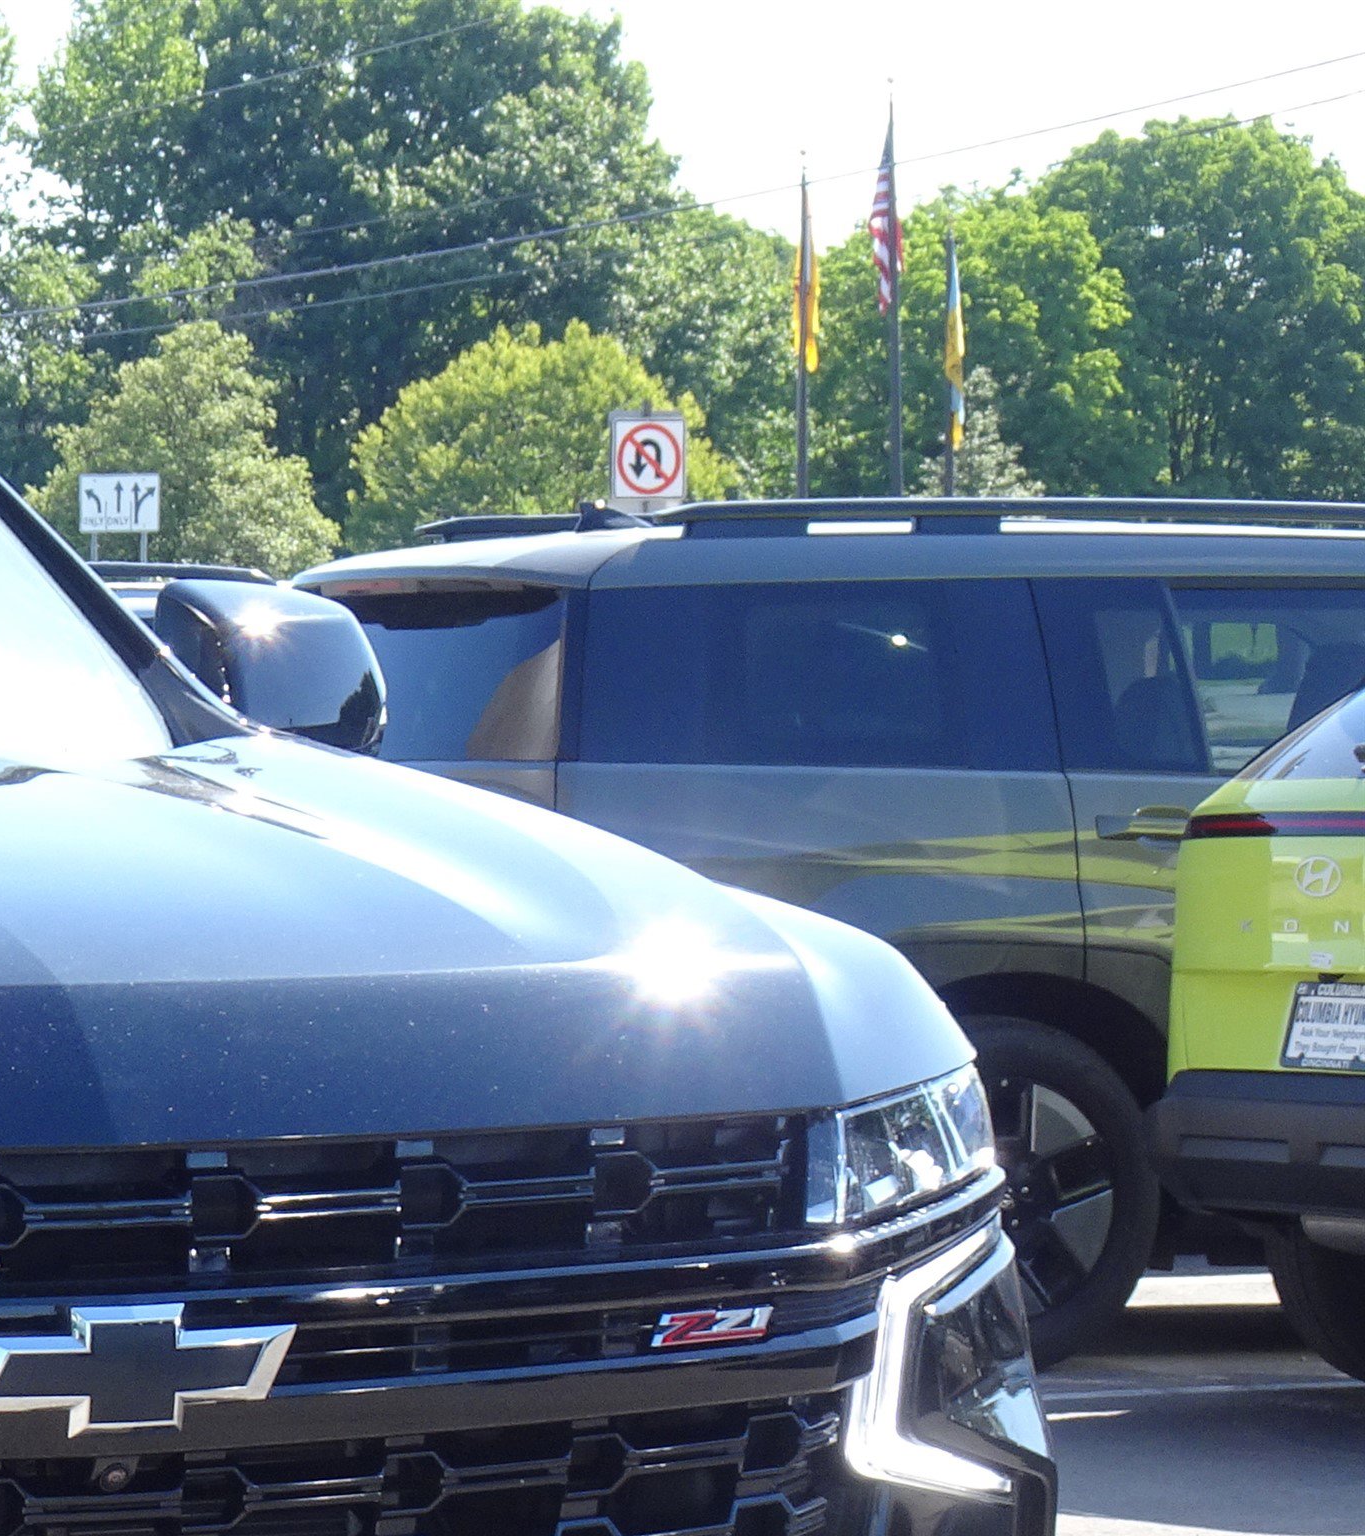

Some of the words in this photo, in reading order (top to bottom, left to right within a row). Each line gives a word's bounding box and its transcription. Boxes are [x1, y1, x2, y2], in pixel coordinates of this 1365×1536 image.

[107, 516, 129, 526] ONLY
[1294, 1001, 1340, 1024] COLUMBIA
[650, 1303, 775, 1348] Z71
